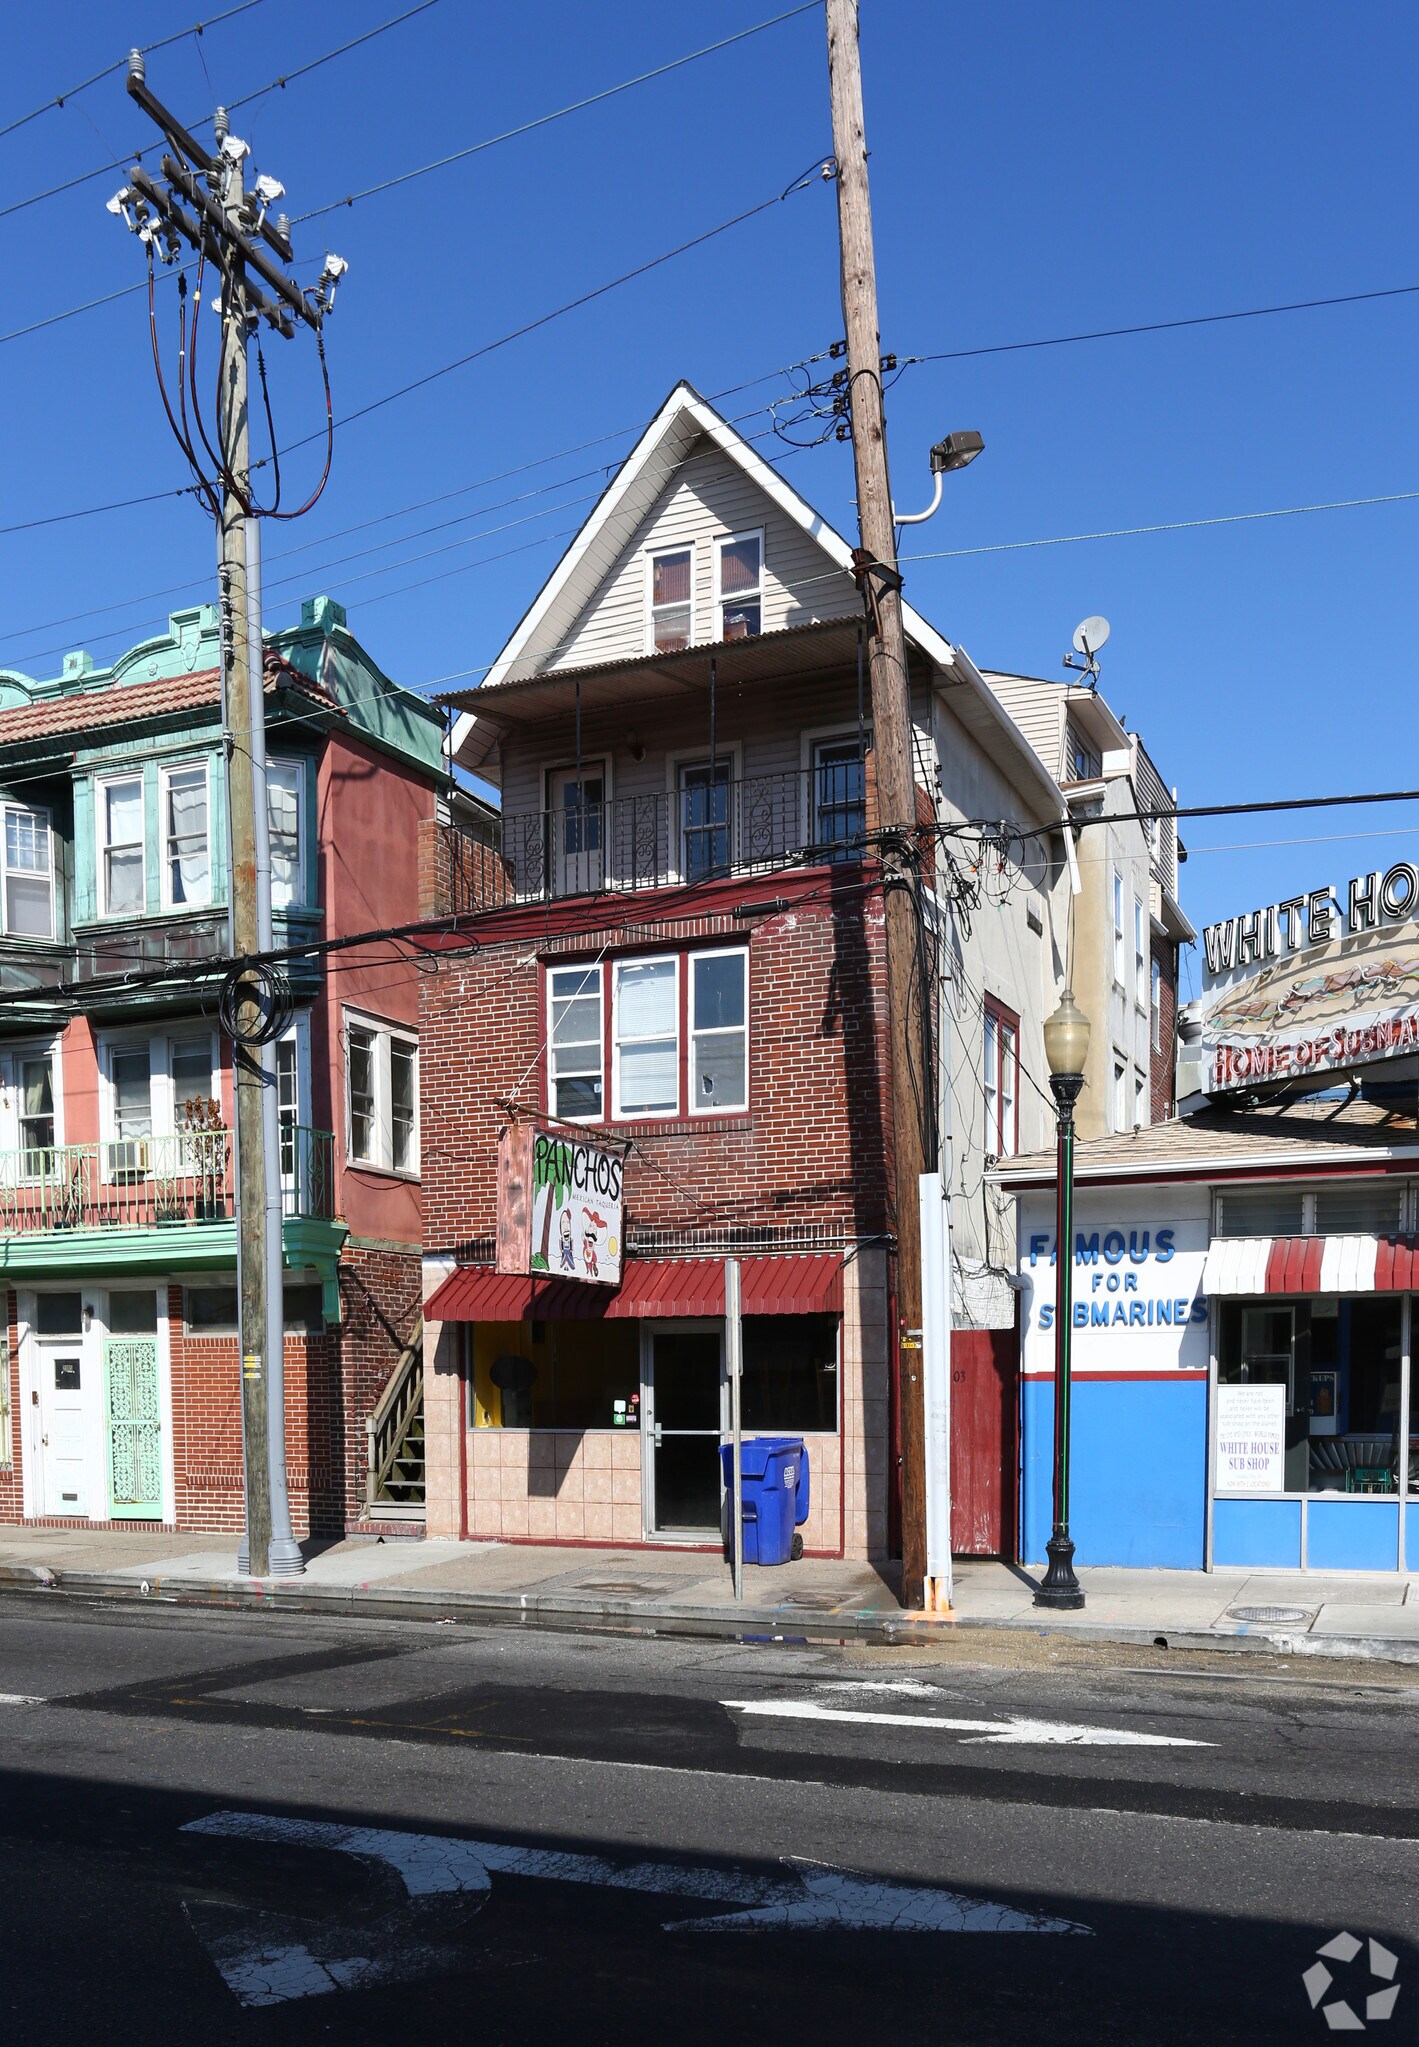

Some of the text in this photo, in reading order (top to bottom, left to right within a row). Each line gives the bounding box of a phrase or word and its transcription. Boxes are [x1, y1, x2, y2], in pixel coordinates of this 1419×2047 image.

[1203, 886, 1337, 975] WHITE
[1212, 1043, 1291, 1084] HOME
[1294, 1036, 1330, 1067] OF
[535, 1135, 622, 1201] PANCHOS
[572, 1193, 619, 1210] MEXICAN TAQUERIA
[1091, 1272, 1138, 1293] FOR
[1038, 1297, 1208, 1329] SBMARINES
[1219, 1441, 1280, 1454] WHITE HOUSE
[1228, 1457, 1270, 1470] SUB SHOP
